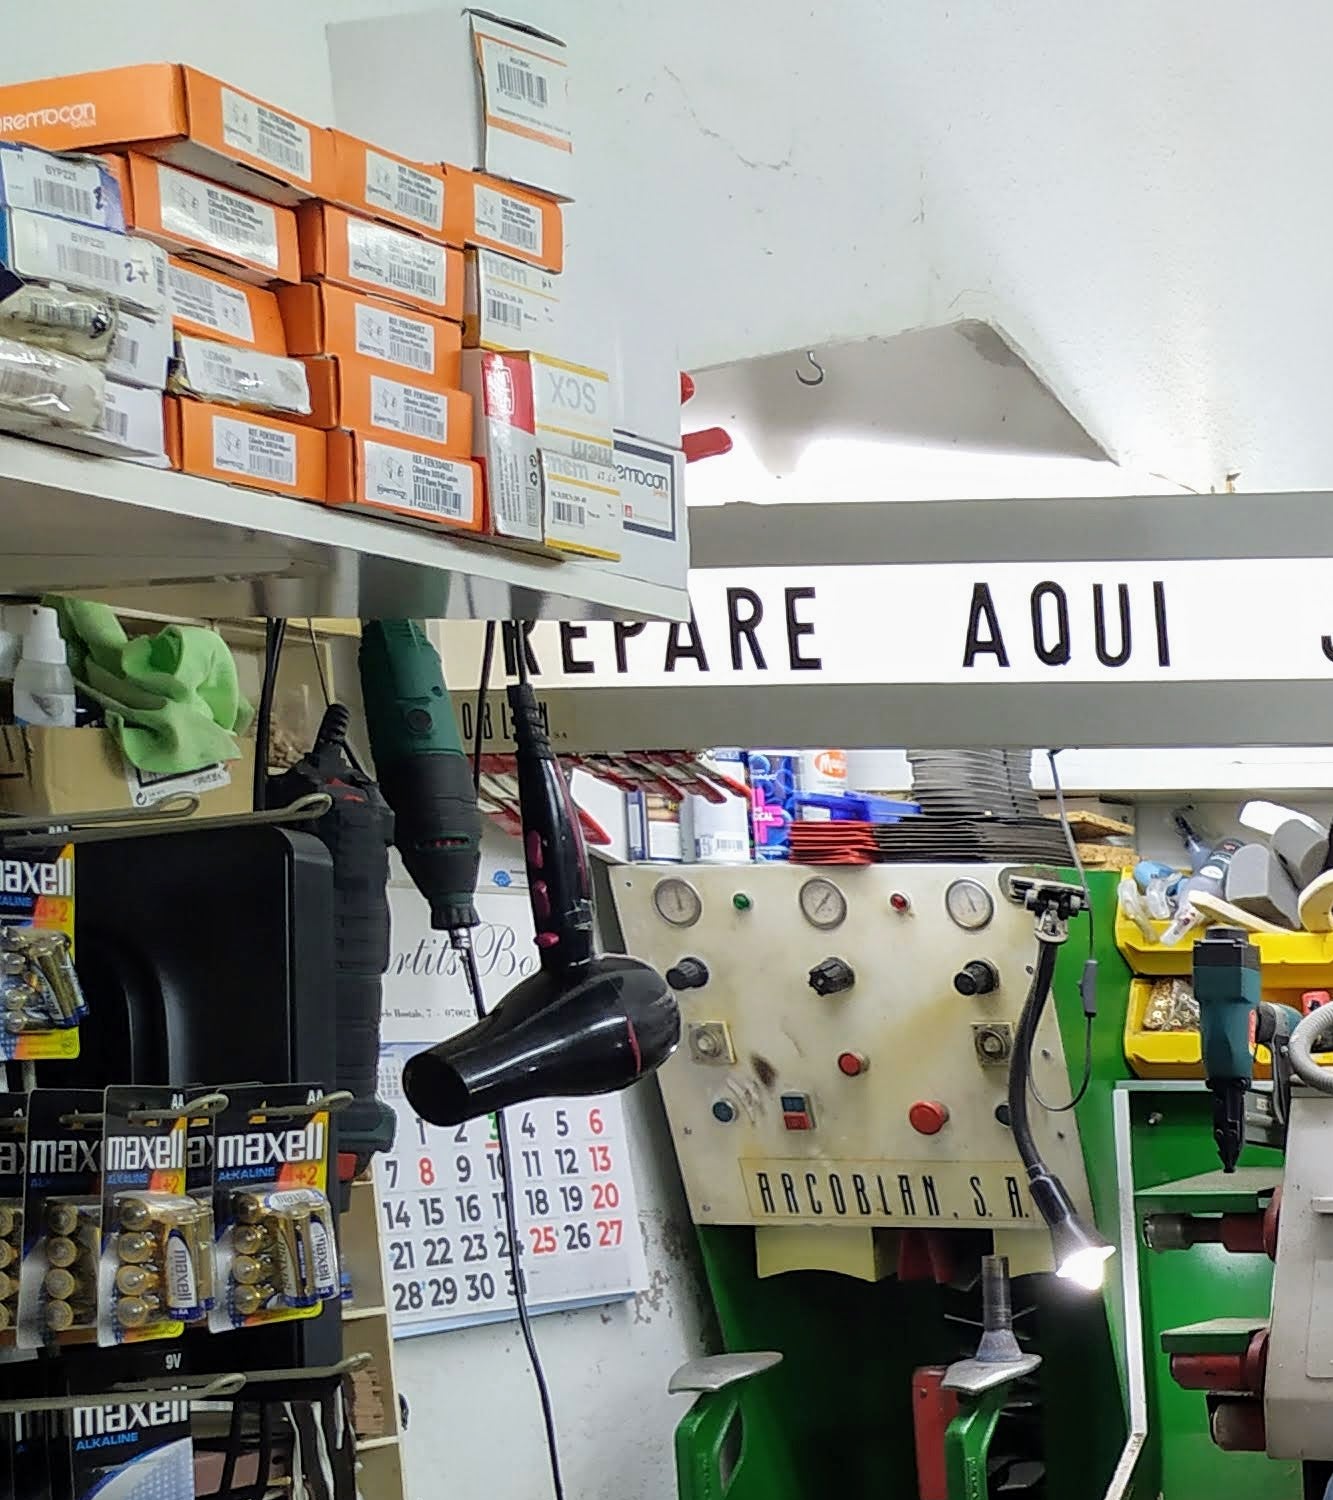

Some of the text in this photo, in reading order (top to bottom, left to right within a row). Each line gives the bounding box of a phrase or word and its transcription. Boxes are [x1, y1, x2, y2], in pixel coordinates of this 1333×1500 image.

[963, 579, 1171, 670] AQUI
[0, 857, 73, 899] axell
[217, 1121, 324, 1168] maxell
[521, 1112, 536, 1139] 4
[555, 1110, 569, 1137] 5
[589, 1109, 604, 1134] 6
[29, 1139, 103, 1174] max
[106, 1129, 185, 1171] maxell
[385, 1160, 398, 1188] 7
[419, 1157, 435, 1186] 8
[456, 1153, 471, 1182] 9
[521, 1150, 543, 1178] 11
[555, 1147, 579, 1174] 12
[588, 1145, 611, 1172] 13
[217, 1166, 275, 1182] ALKALINE
[383, 1182, 619, 1230] 14 15 16 18 19 20
[389, 1241, 415, 1270] 21
[424, 1237, 453, 1267] 22
[460, 1234, 488, 1262] 23
[529, 1225, 557, 1253] 25
[563, 1223, 591, 1250] 26
[598, 1219, 623, 1247] 27
[172, 1249, 189, 1302] maxell
[393, 1283, 422, 1312] 28
[429, 1277, 457, 1306] 29
[465, 1273, 495, 1301] 30
[165, 1352, 182, 1370] 9V
[73, 1390, 189, 1439] maxell
[75, 1431, 139, 1452] ALKALINE
